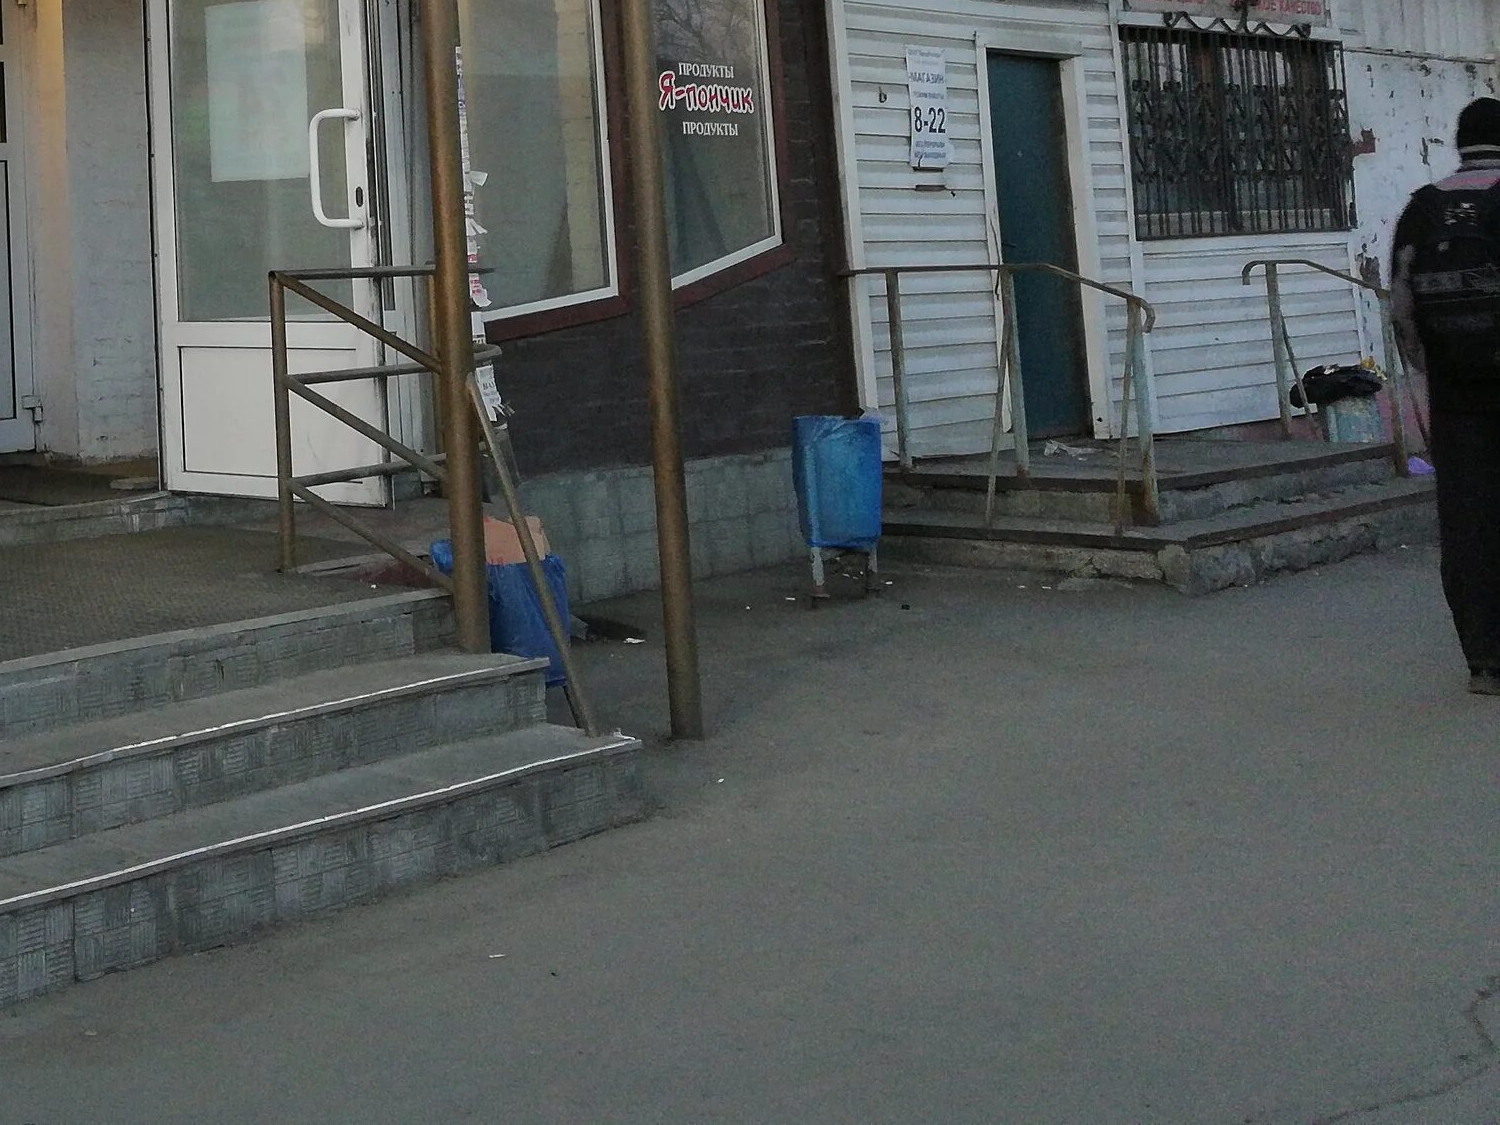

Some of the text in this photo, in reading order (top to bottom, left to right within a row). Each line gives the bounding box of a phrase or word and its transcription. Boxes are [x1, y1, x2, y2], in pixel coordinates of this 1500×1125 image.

[678, 62, 735, 79] ПРОДУКТЫ
[914, 106, 946, 133] 8-22
[682, 121, 739, 136] ПРОДУКТЫ
